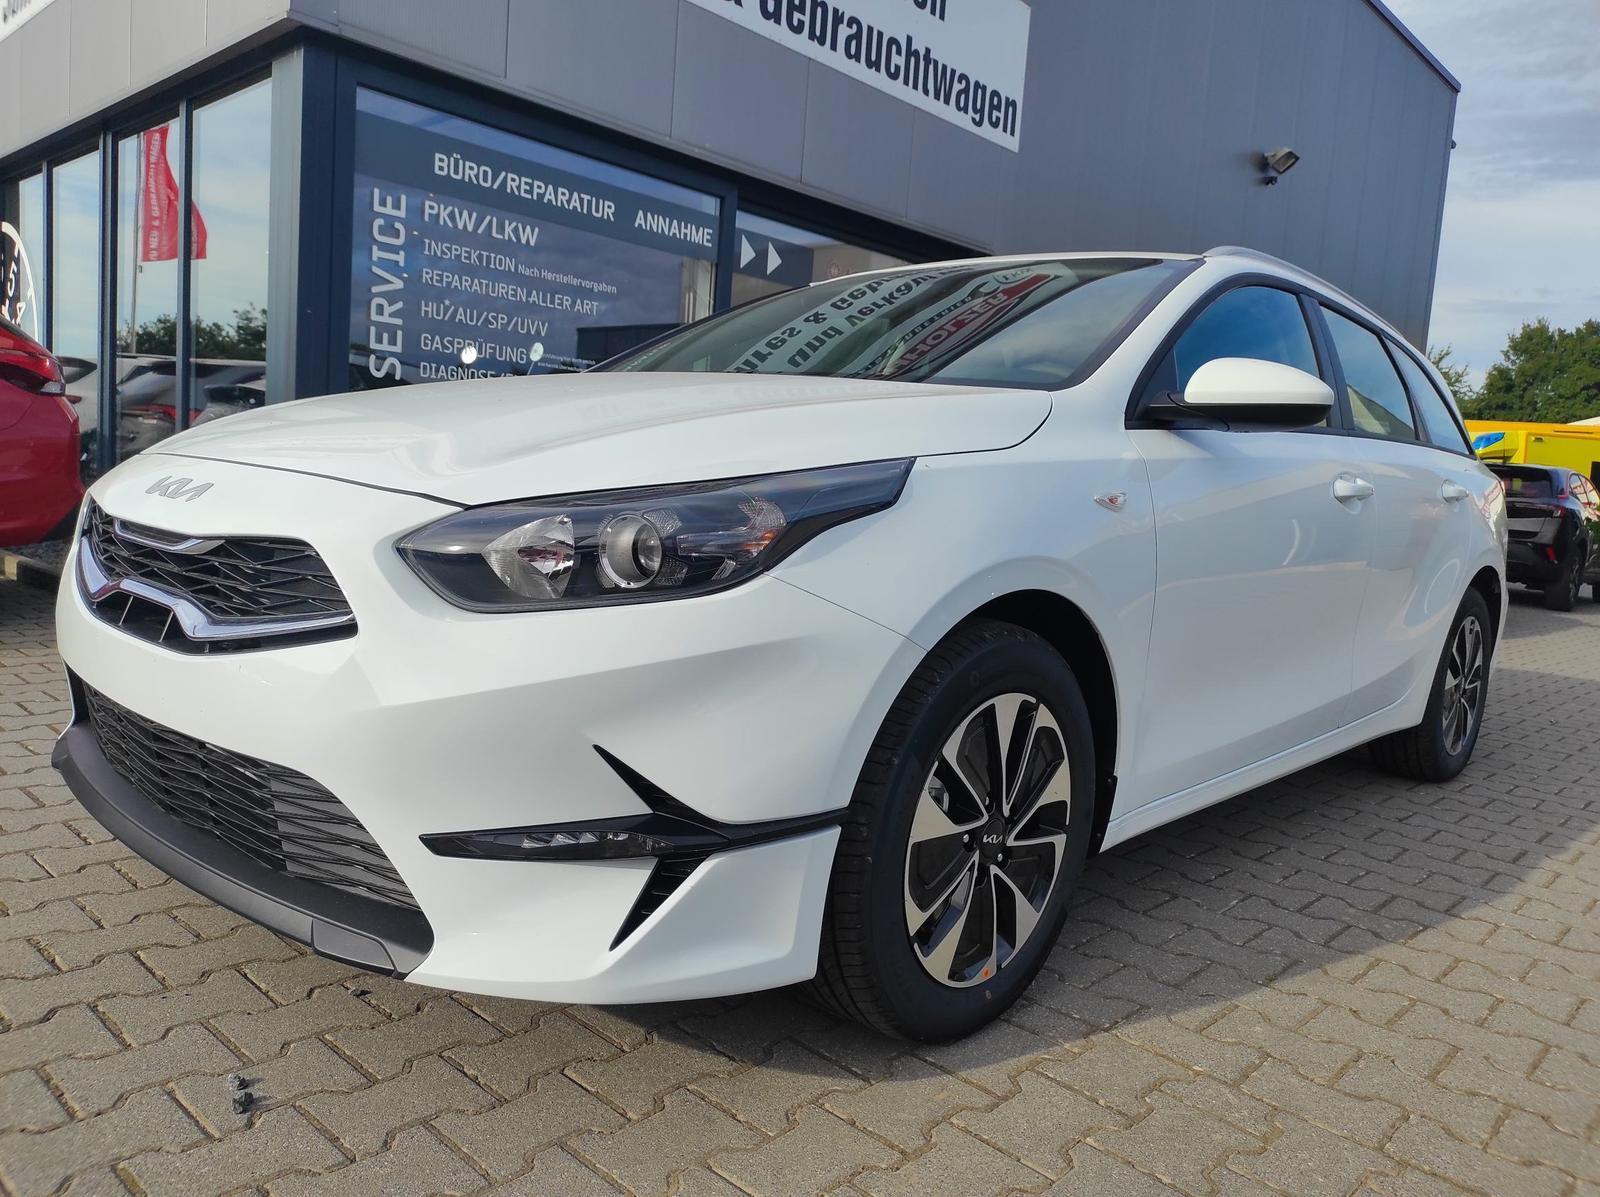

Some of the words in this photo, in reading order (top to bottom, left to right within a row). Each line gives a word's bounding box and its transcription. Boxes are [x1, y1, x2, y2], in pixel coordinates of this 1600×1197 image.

[423, 199, 540, 248] PKW/LKW
[434, 152, 616, 222] BÜRO/REPARATUR
[634, 209, 714, 248] ANNAHME
[367, 186, 407, 382] SERVICE
[422, 238, 516, 272] INSPEKTION
[518, 263, 540, 278] Nach
[541, 268, 618, 295] Herstellervorgaben
[421, 268, 527, 303] REPARATUREN
[529, 289, 572, 312] ALLER
[574, 299, 600, 316] ART
[420, 300, 549, 337] HU/AU/SP/UVV
[145, 475, 215, 502] KIA
